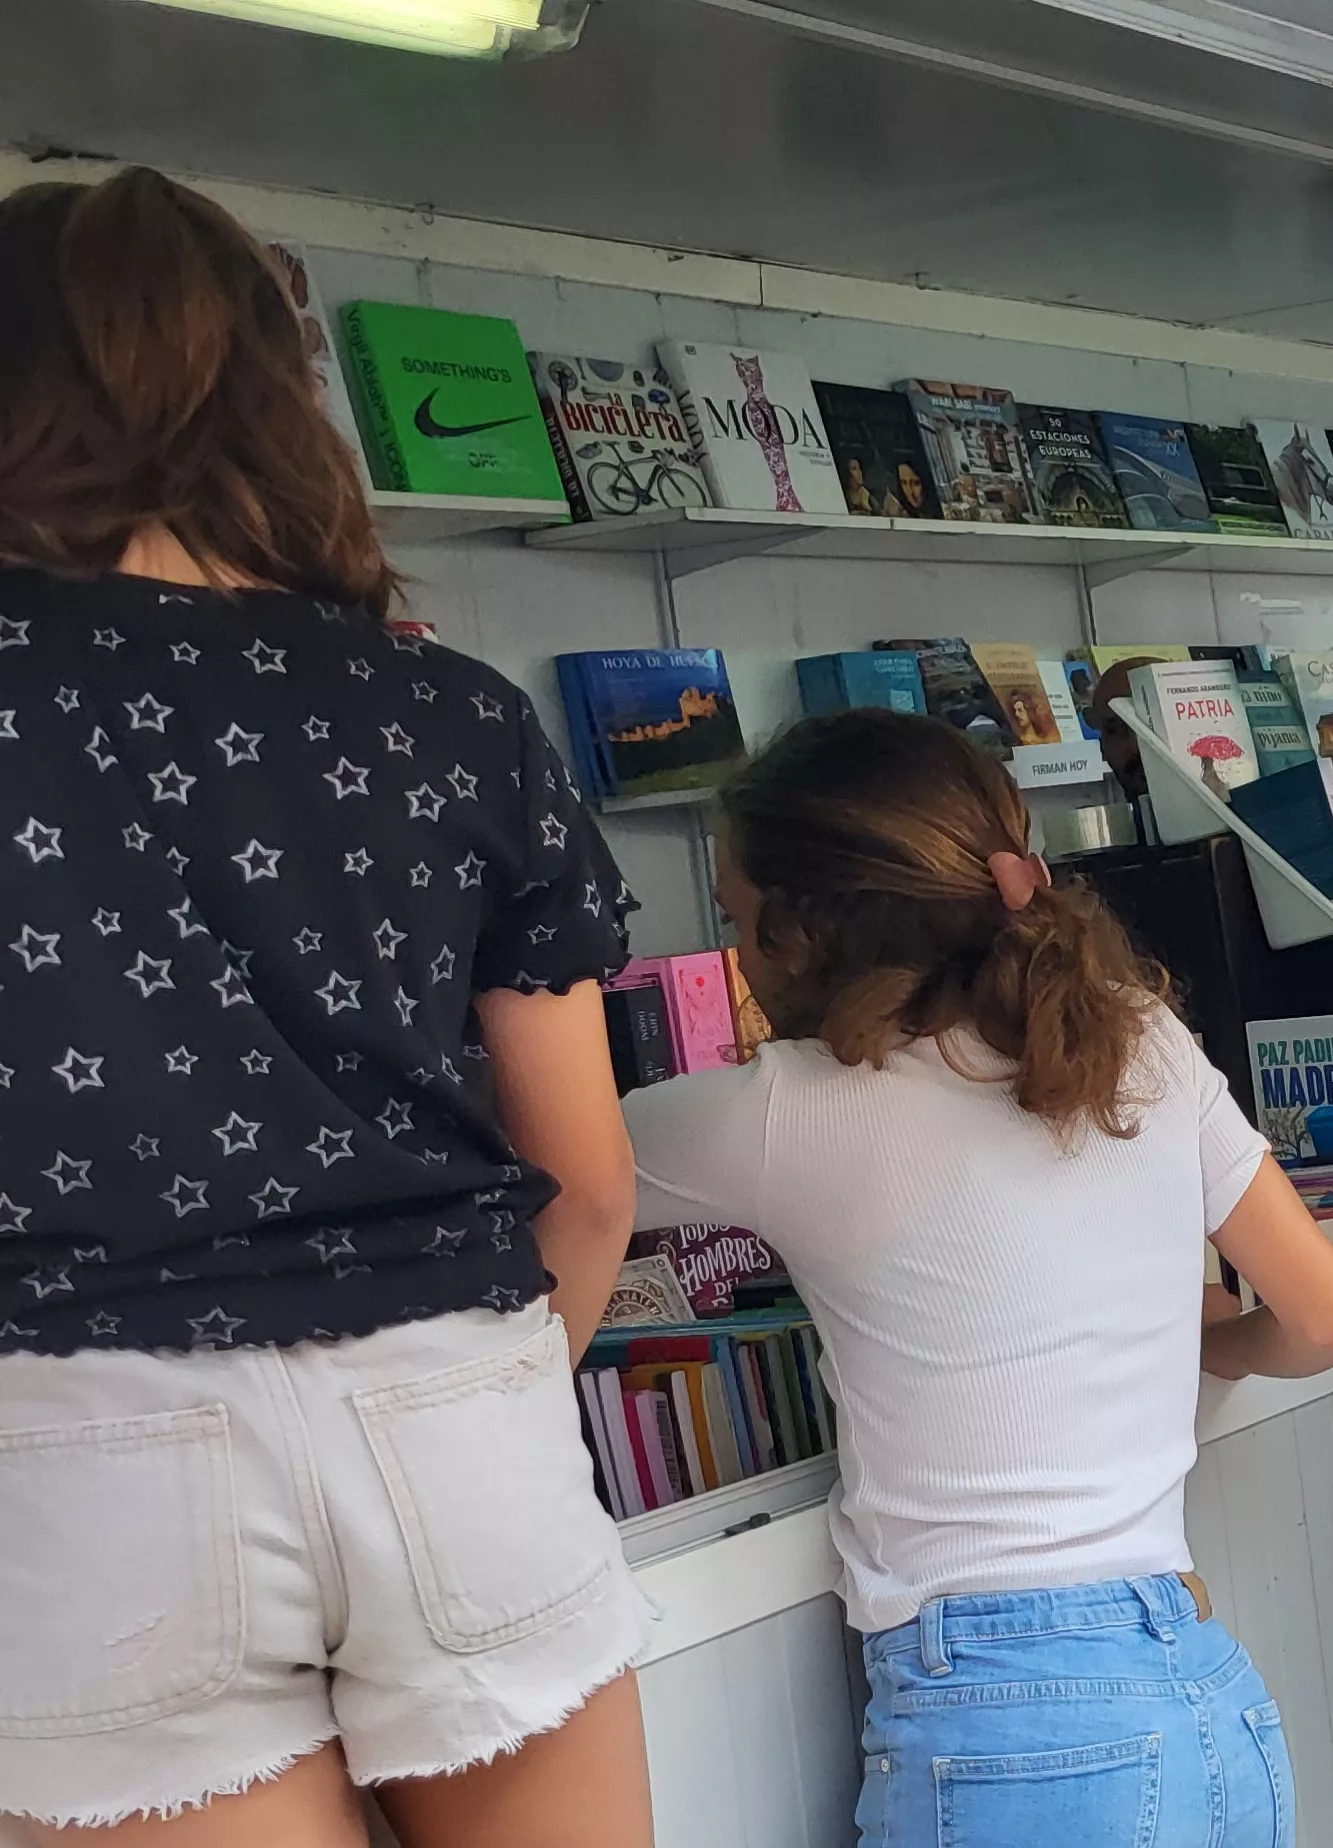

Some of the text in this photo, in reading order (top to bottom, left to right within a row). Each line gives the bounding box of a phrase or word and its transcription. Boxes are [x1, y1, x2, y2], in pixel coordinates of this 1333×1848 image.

[402, 356, 512, 384] SOMETHING'S
[702, 397, 829, 449] MODA
[1029, 429, 1091, 444] ESTACIONES
[1039, 444, 1092, 460] EUROPEAS
[601, 657, 641, 669] HOYA
[1175, 699, 1235, 720] PATRIA
[1257, 729, 1301, 748] pijama
[1032, 760, 1088, 776] FIRMAN HOY
[1257, 1041, 1289, 1067] PAZ
[679, 1235, 772, 1297] HOMBRES
